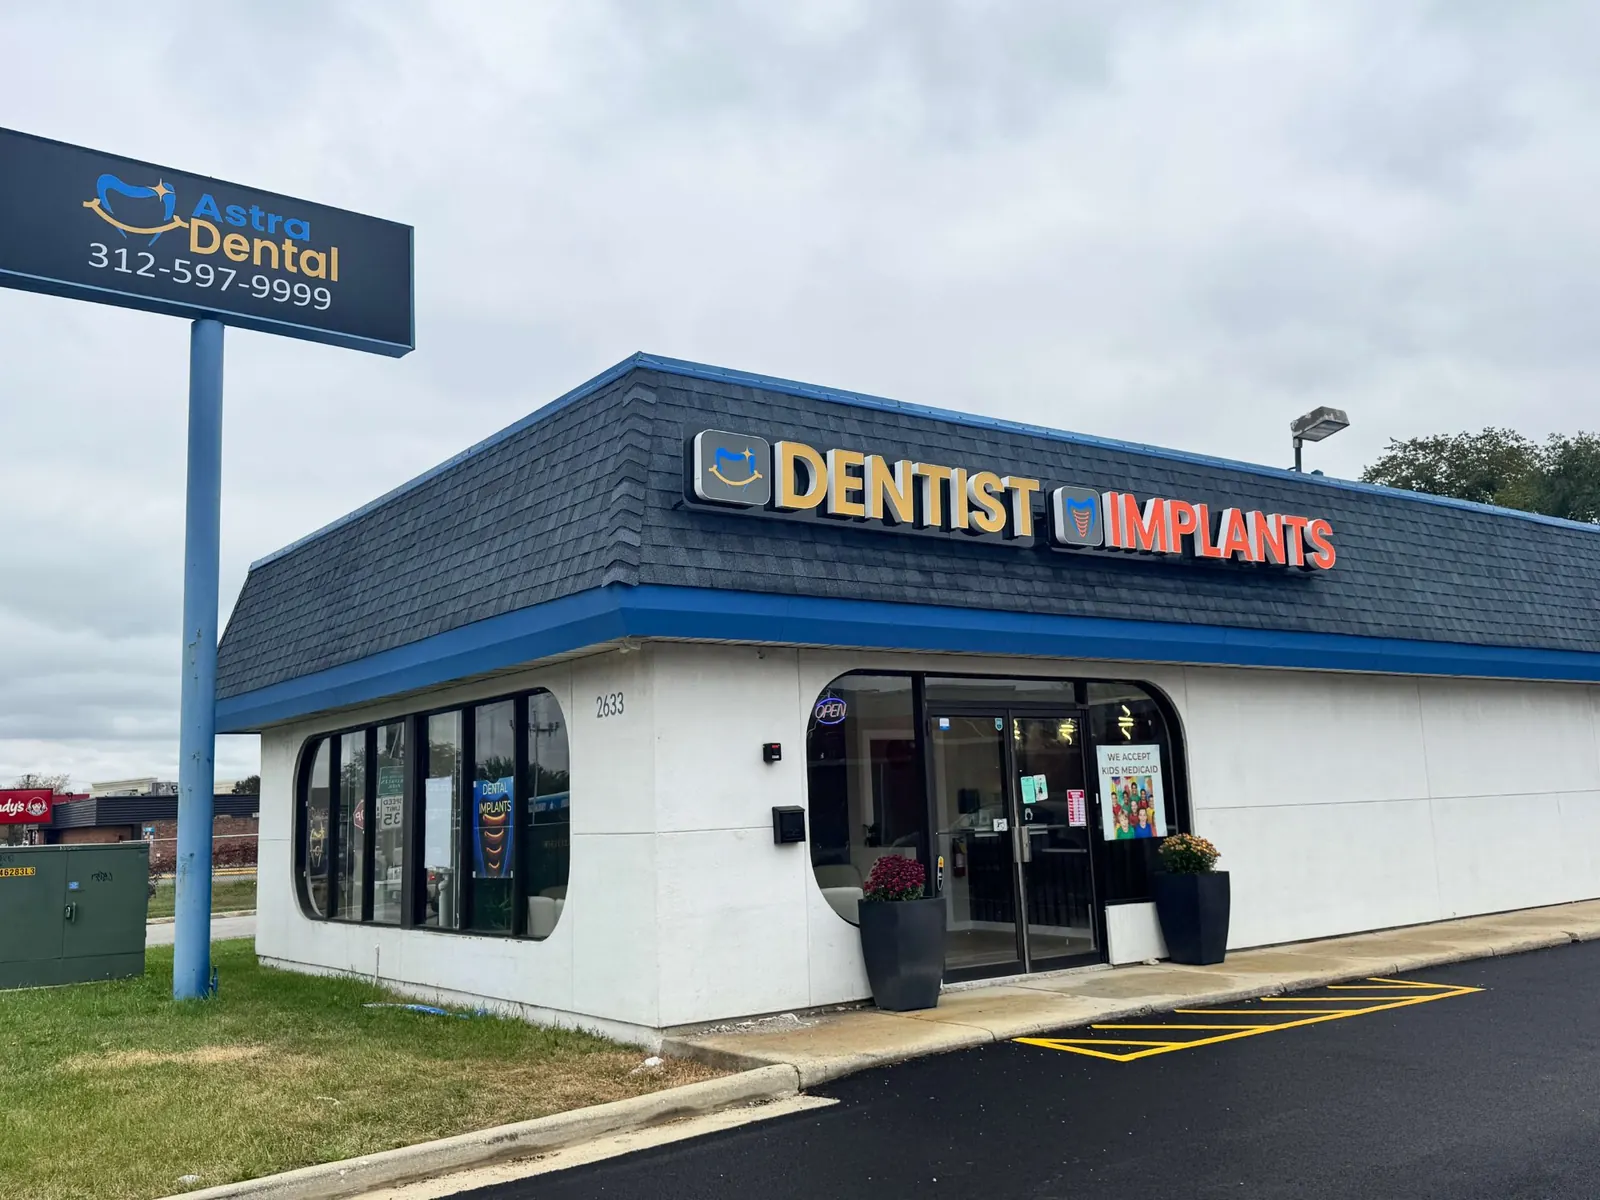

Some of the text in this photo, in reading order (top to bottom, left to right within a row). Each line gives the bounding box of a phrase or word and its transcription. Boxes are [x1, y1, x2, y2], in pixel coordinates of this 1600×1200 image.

[192, 193, 310, 242] Astra
[189, 217, 339, 282] Dental
[88, 242, 332, 311] 312-597-9999
[775, 440, 1040, 537] DENTIST
[1101, 491, 1337, 570] IMPLANTS
[596, 691, 625, 719] 2633
[815, 703, 847, 719] OPEN
[1101, 765, 1159, 775] KIDS MEDICAID
[1107, 752, 1151, 761] WE ACCEPT
[482, 782, 508, 795] DENTAL
[479, 800, 512, 814] IMPLANTS
